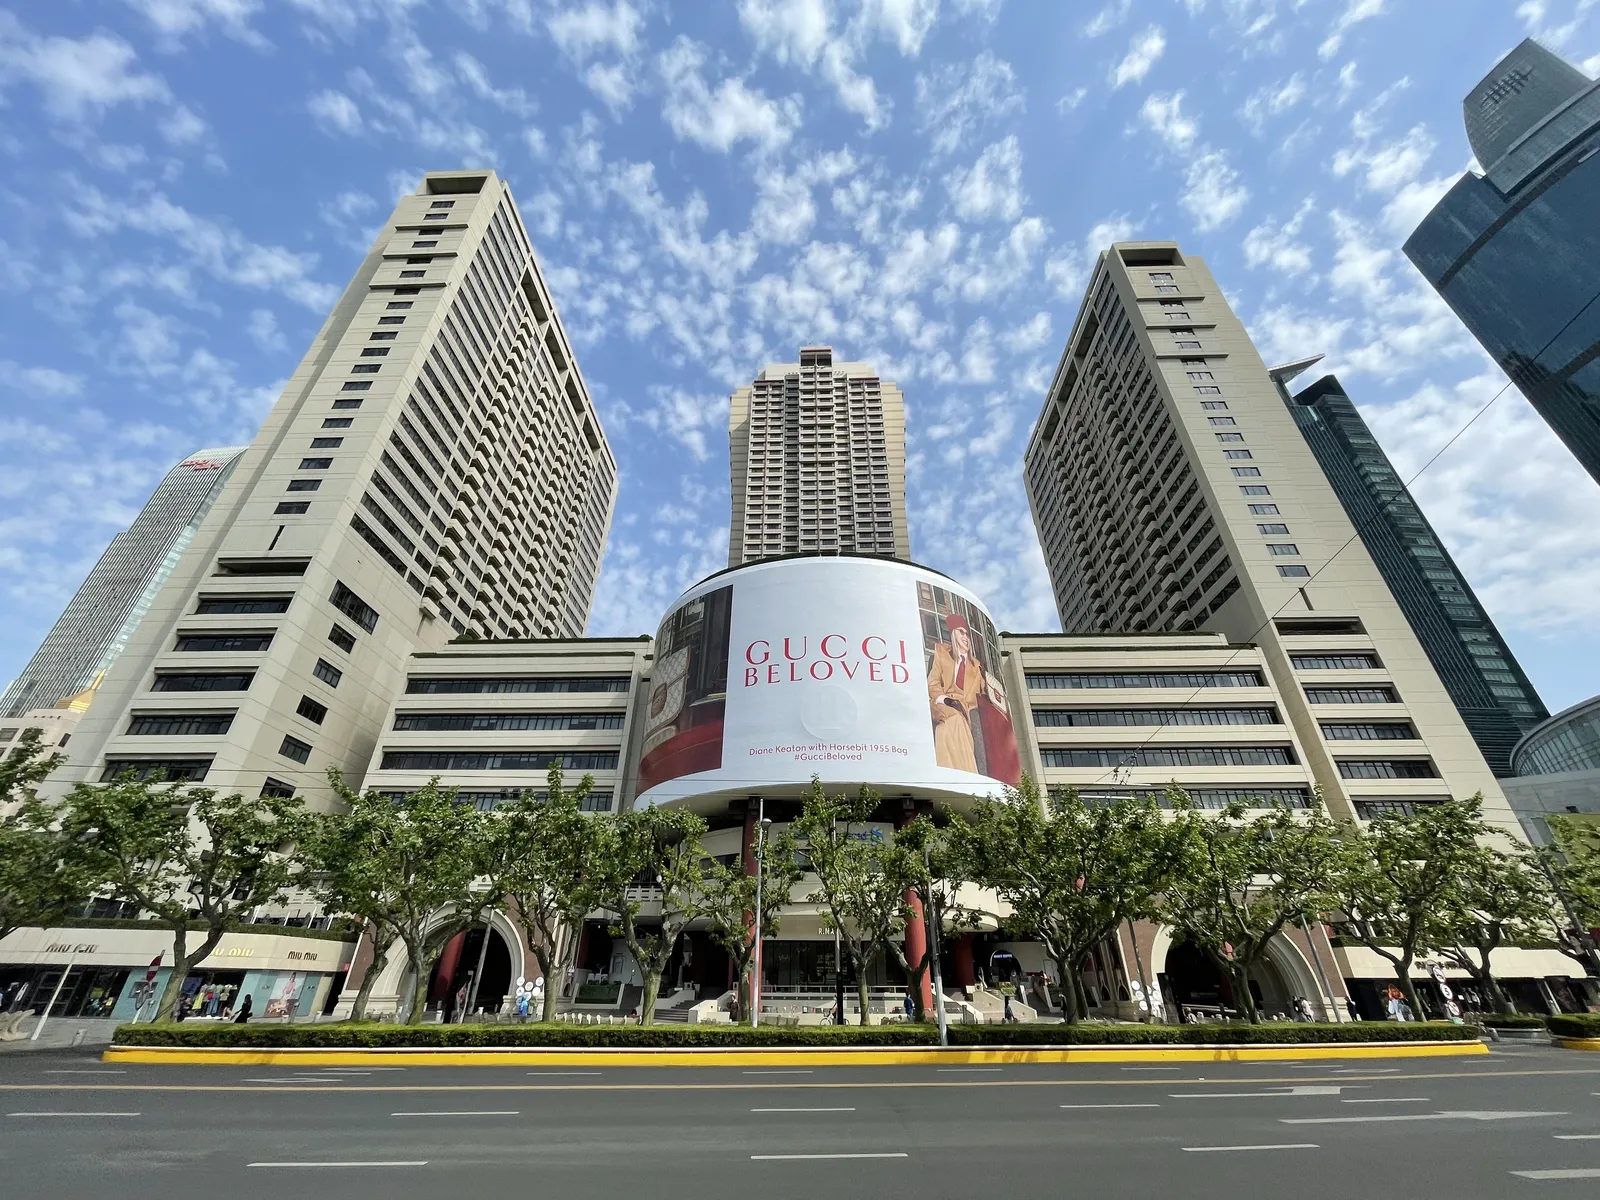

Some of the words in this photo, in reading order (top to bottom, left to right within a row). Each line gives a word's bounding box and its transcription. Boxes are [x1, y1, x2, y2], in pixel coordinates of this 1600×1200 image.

[745, 634, 907, 664] GUCCI
[744, 660, 910, 687] BELOVED
[749, 748, 773, 756] Diane
[775, 745, 806, 753] Keaton
[808, 743, 827, 751] with
[829, 743, 867, 751] Horsebit
[869, 744, 889, 752] 1955
[891, 746, 908, 756] Bag
[794, 752, 862, 761] #GucciBeloved
[287, 951, 302, 960] MIU
[303, 952, 318, 961] MIU
